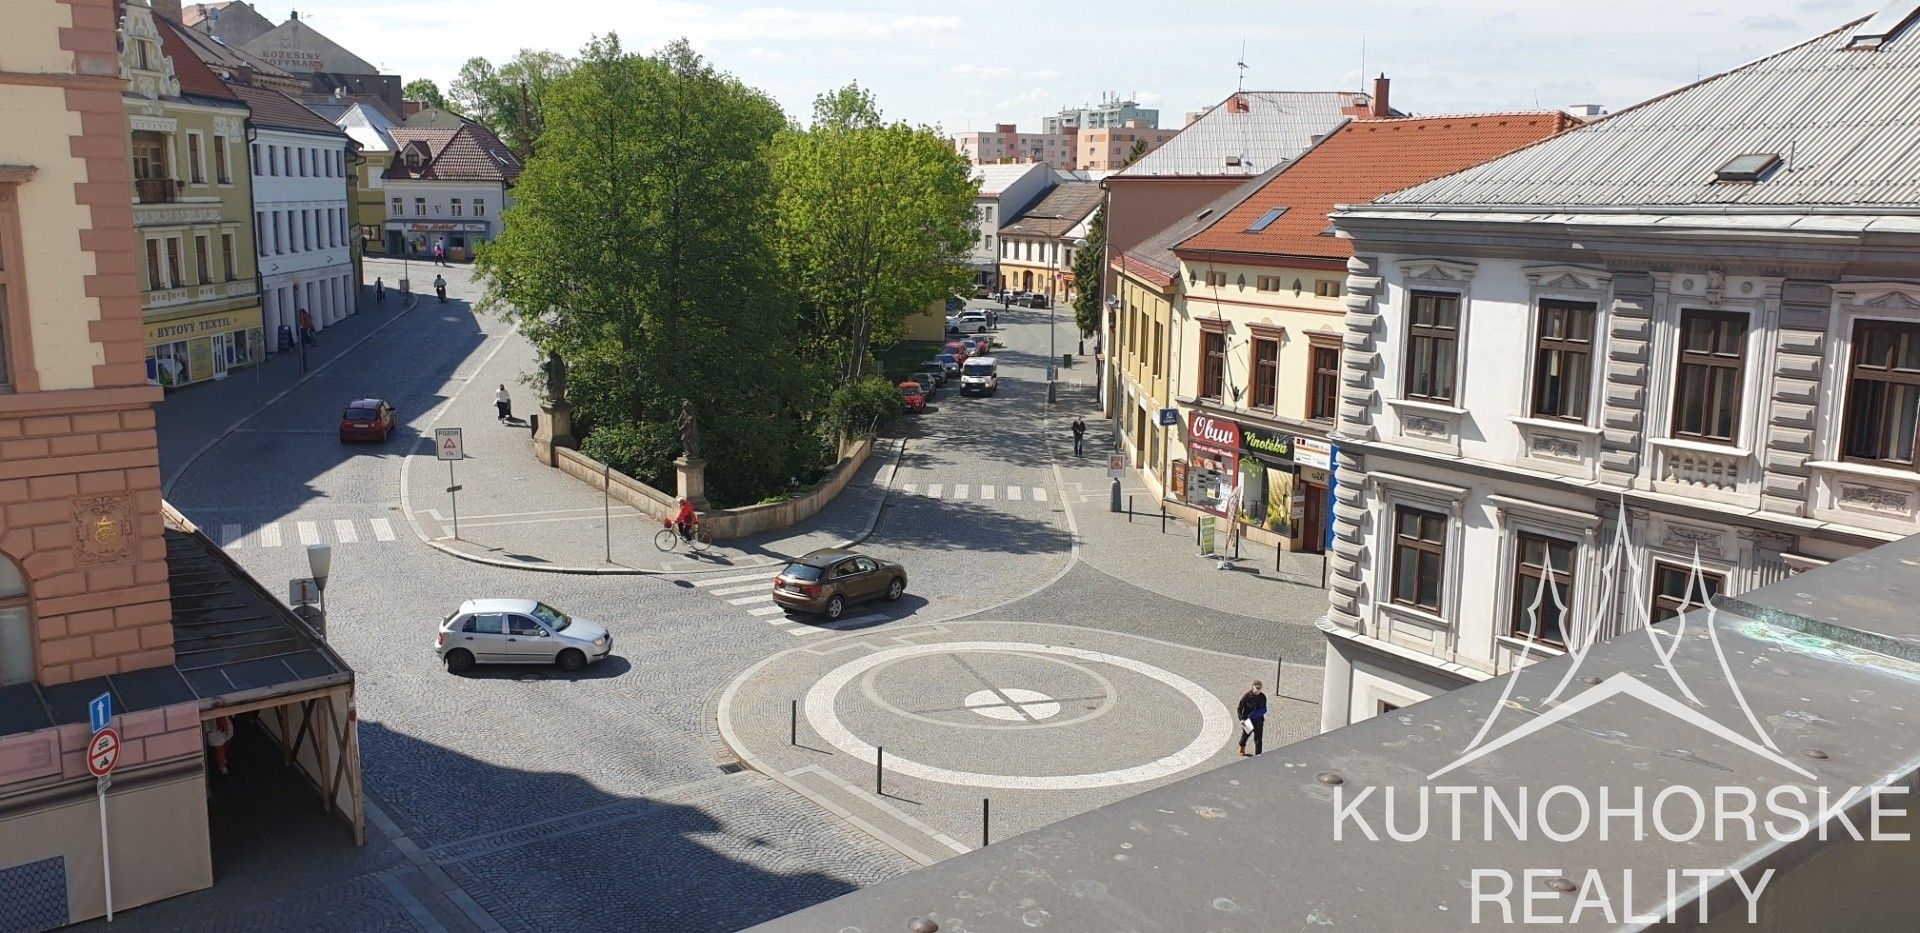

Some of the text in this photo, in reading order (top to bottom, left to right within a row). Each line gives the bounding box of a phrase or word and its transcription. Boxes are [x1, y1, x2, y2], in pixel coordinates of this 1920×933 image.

[198, 317, 231, 330] TEXTIL
[1193, 415, 1234, 445] Obuv
[1244, 431, 1288, 454] Vinotéka
